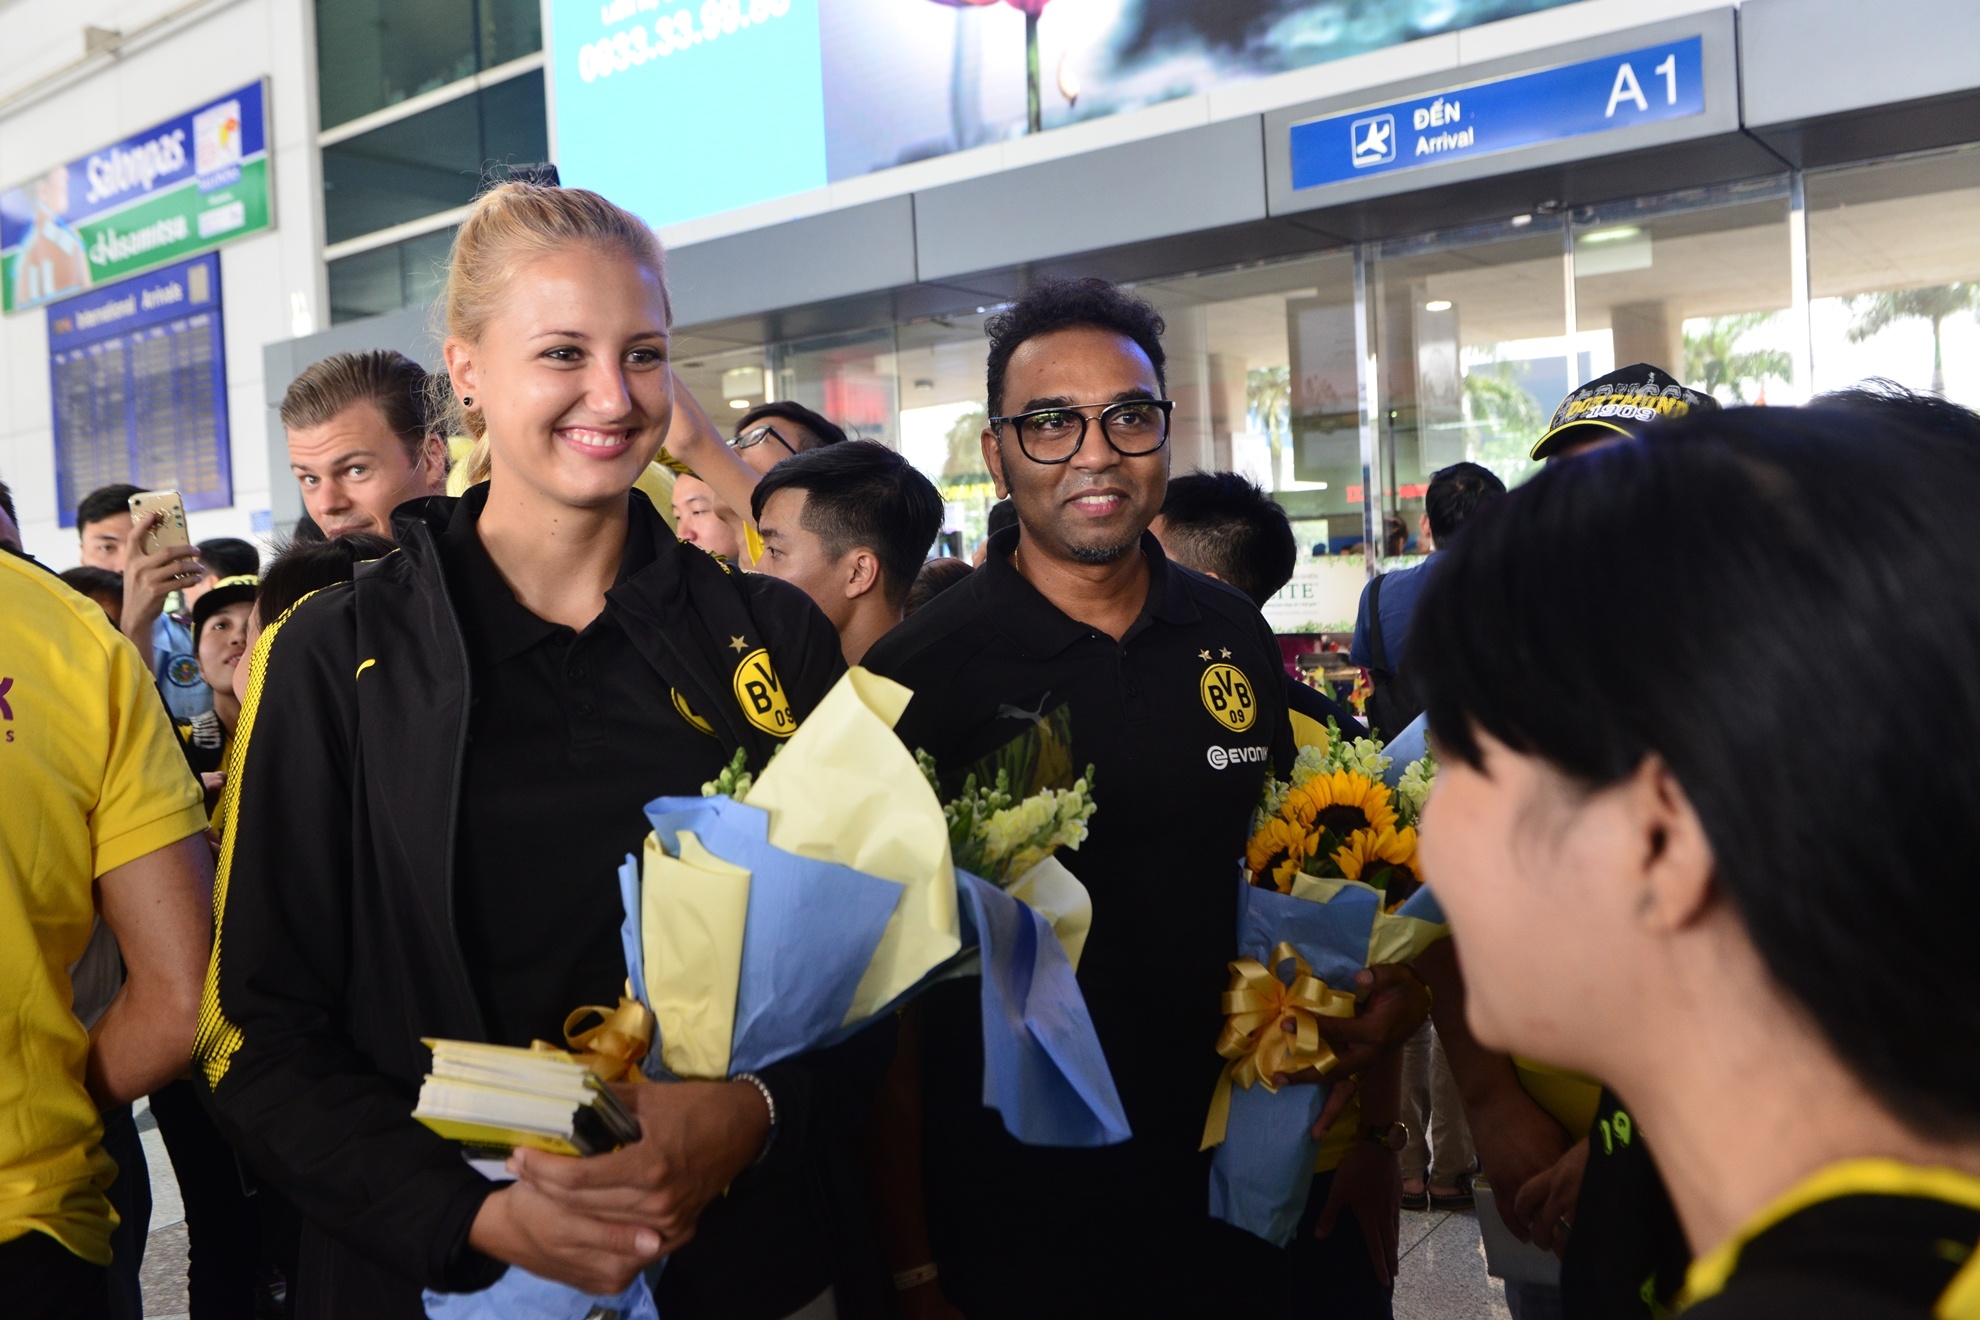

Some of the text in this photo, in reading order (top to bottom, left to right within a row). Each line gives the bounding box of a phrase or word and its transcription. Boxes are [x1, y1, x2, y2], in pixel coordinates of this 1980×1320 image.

[1413, 97, 1461, 131] ĐẾN
[1415, 126, 1475, 157] Arrival
[1586, 404, 1657, 422] 1909
[1271, 583, 1315, 599] ITE
[1208, 670, 1252, 711] BVB
[1229, 709, 1245, 724] 09
